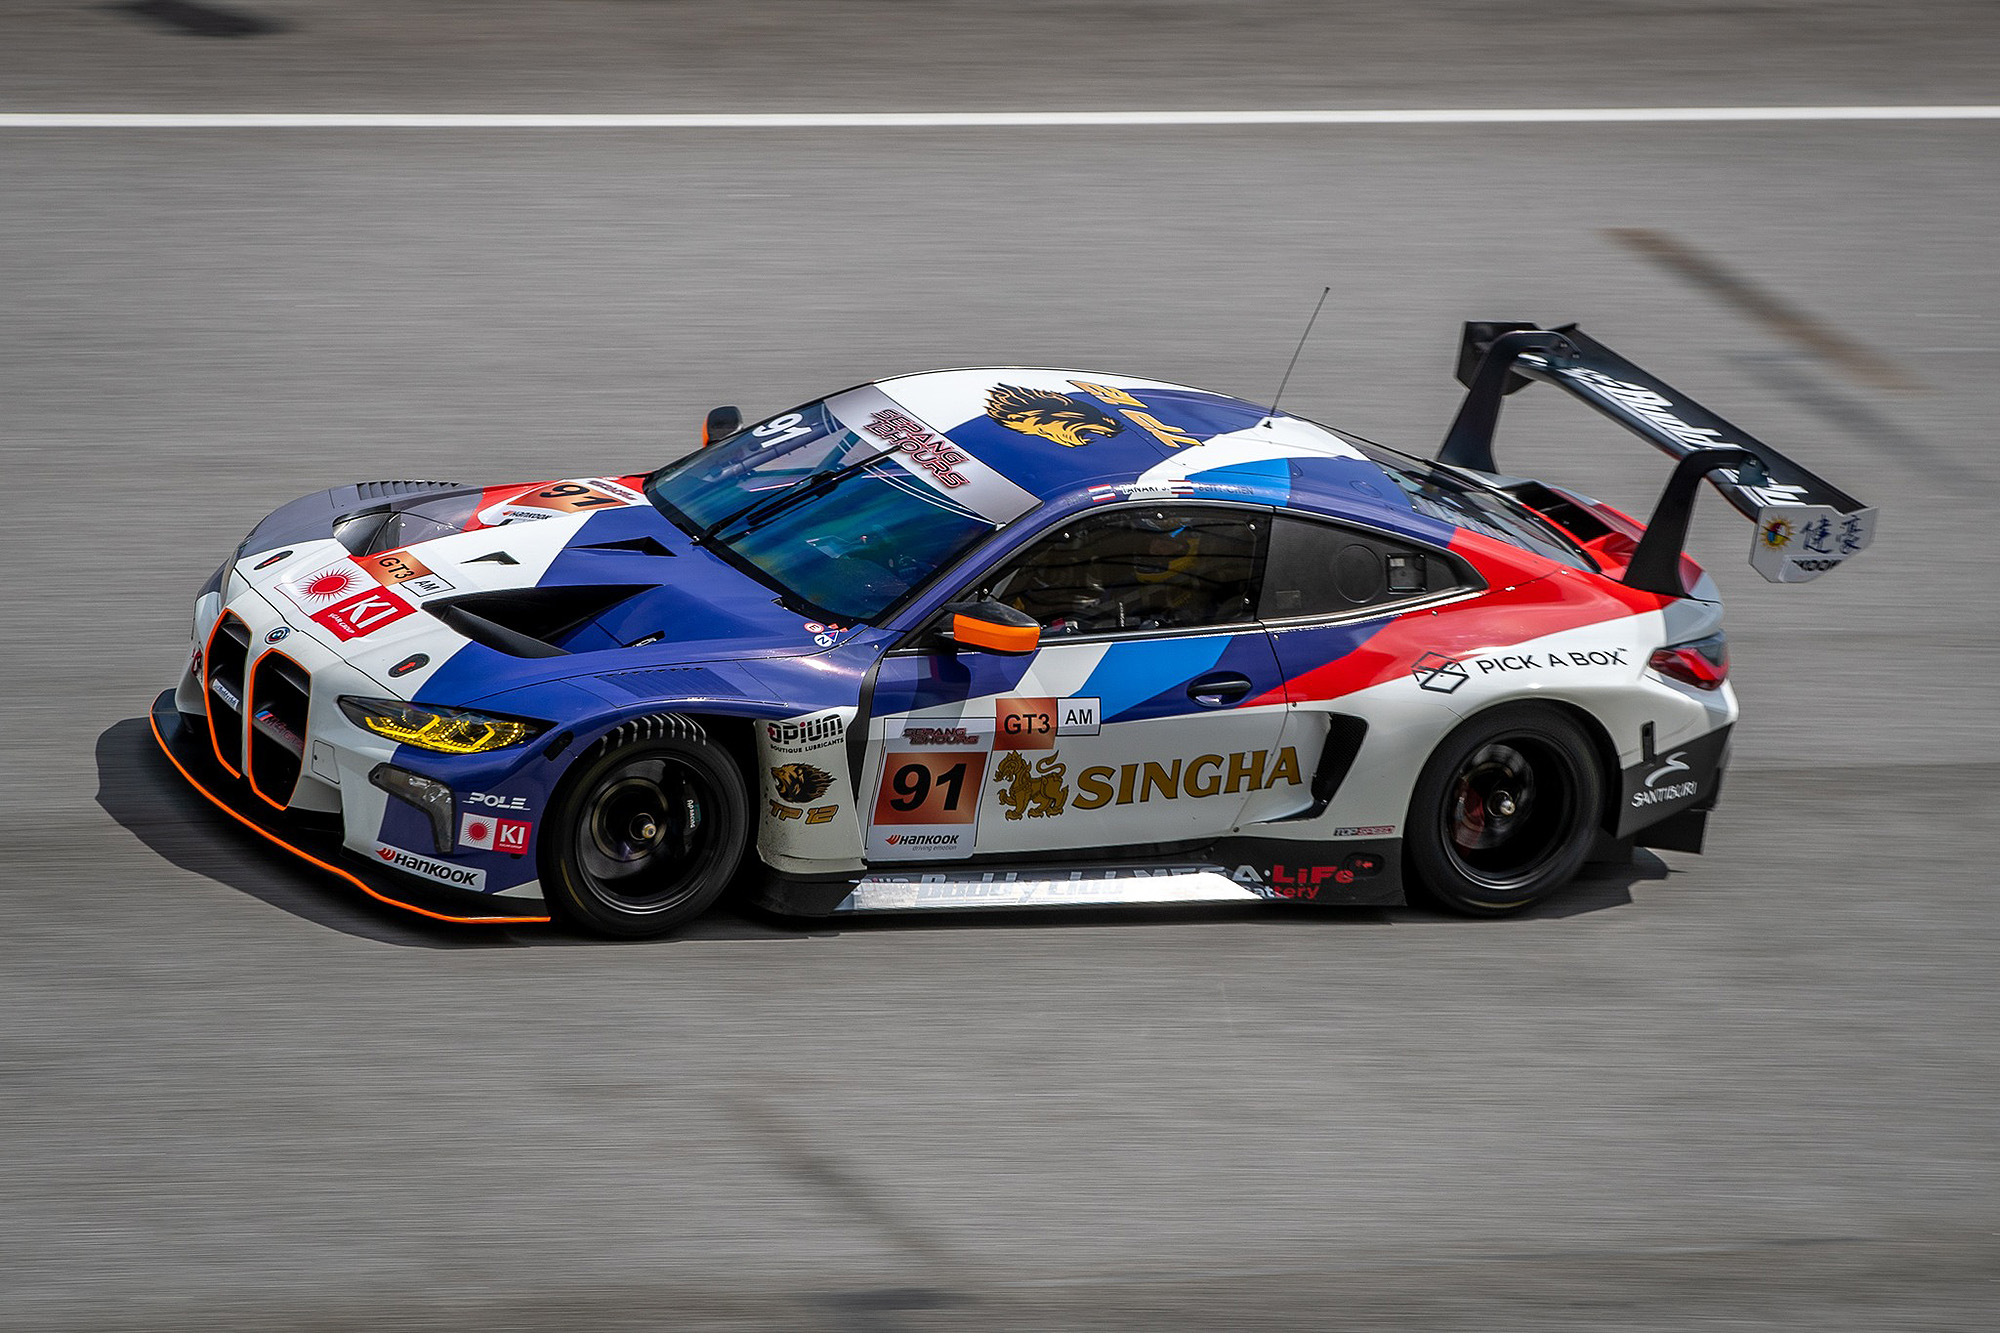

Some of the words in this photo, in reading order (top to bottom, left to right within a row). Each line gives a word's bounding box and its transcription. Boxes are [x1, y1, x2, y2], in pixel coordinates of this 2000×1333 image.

[752, 413, 812, 448] 91
[870, 409, 970, 465] SEPANG
[539, 484, 618, 507] 91
[379, 557, 415, 579] GT3
[415, 580, 440, 592] AM
[339, 594, 399, 629] KI
[1476, 655, 1543, 674] PICK
[1548, 653, 1569, 667] A
[1568, 651, 1628, 666] BOX
[1003, 713, 1051, 735] GT3
[1065, 709, 1093, 725] AM
[770, 743, 802, 754] BOUTIQUE
[805, 737, 844, 752] LUBRICANTS
[890, 763, 967, 813] 91
[1072, 746, 1302, 811] SINGHA
[463, 792, 531, 811] POLE
[500, 824, 526, 845] KI
[912, 845, 932, 853] driving
